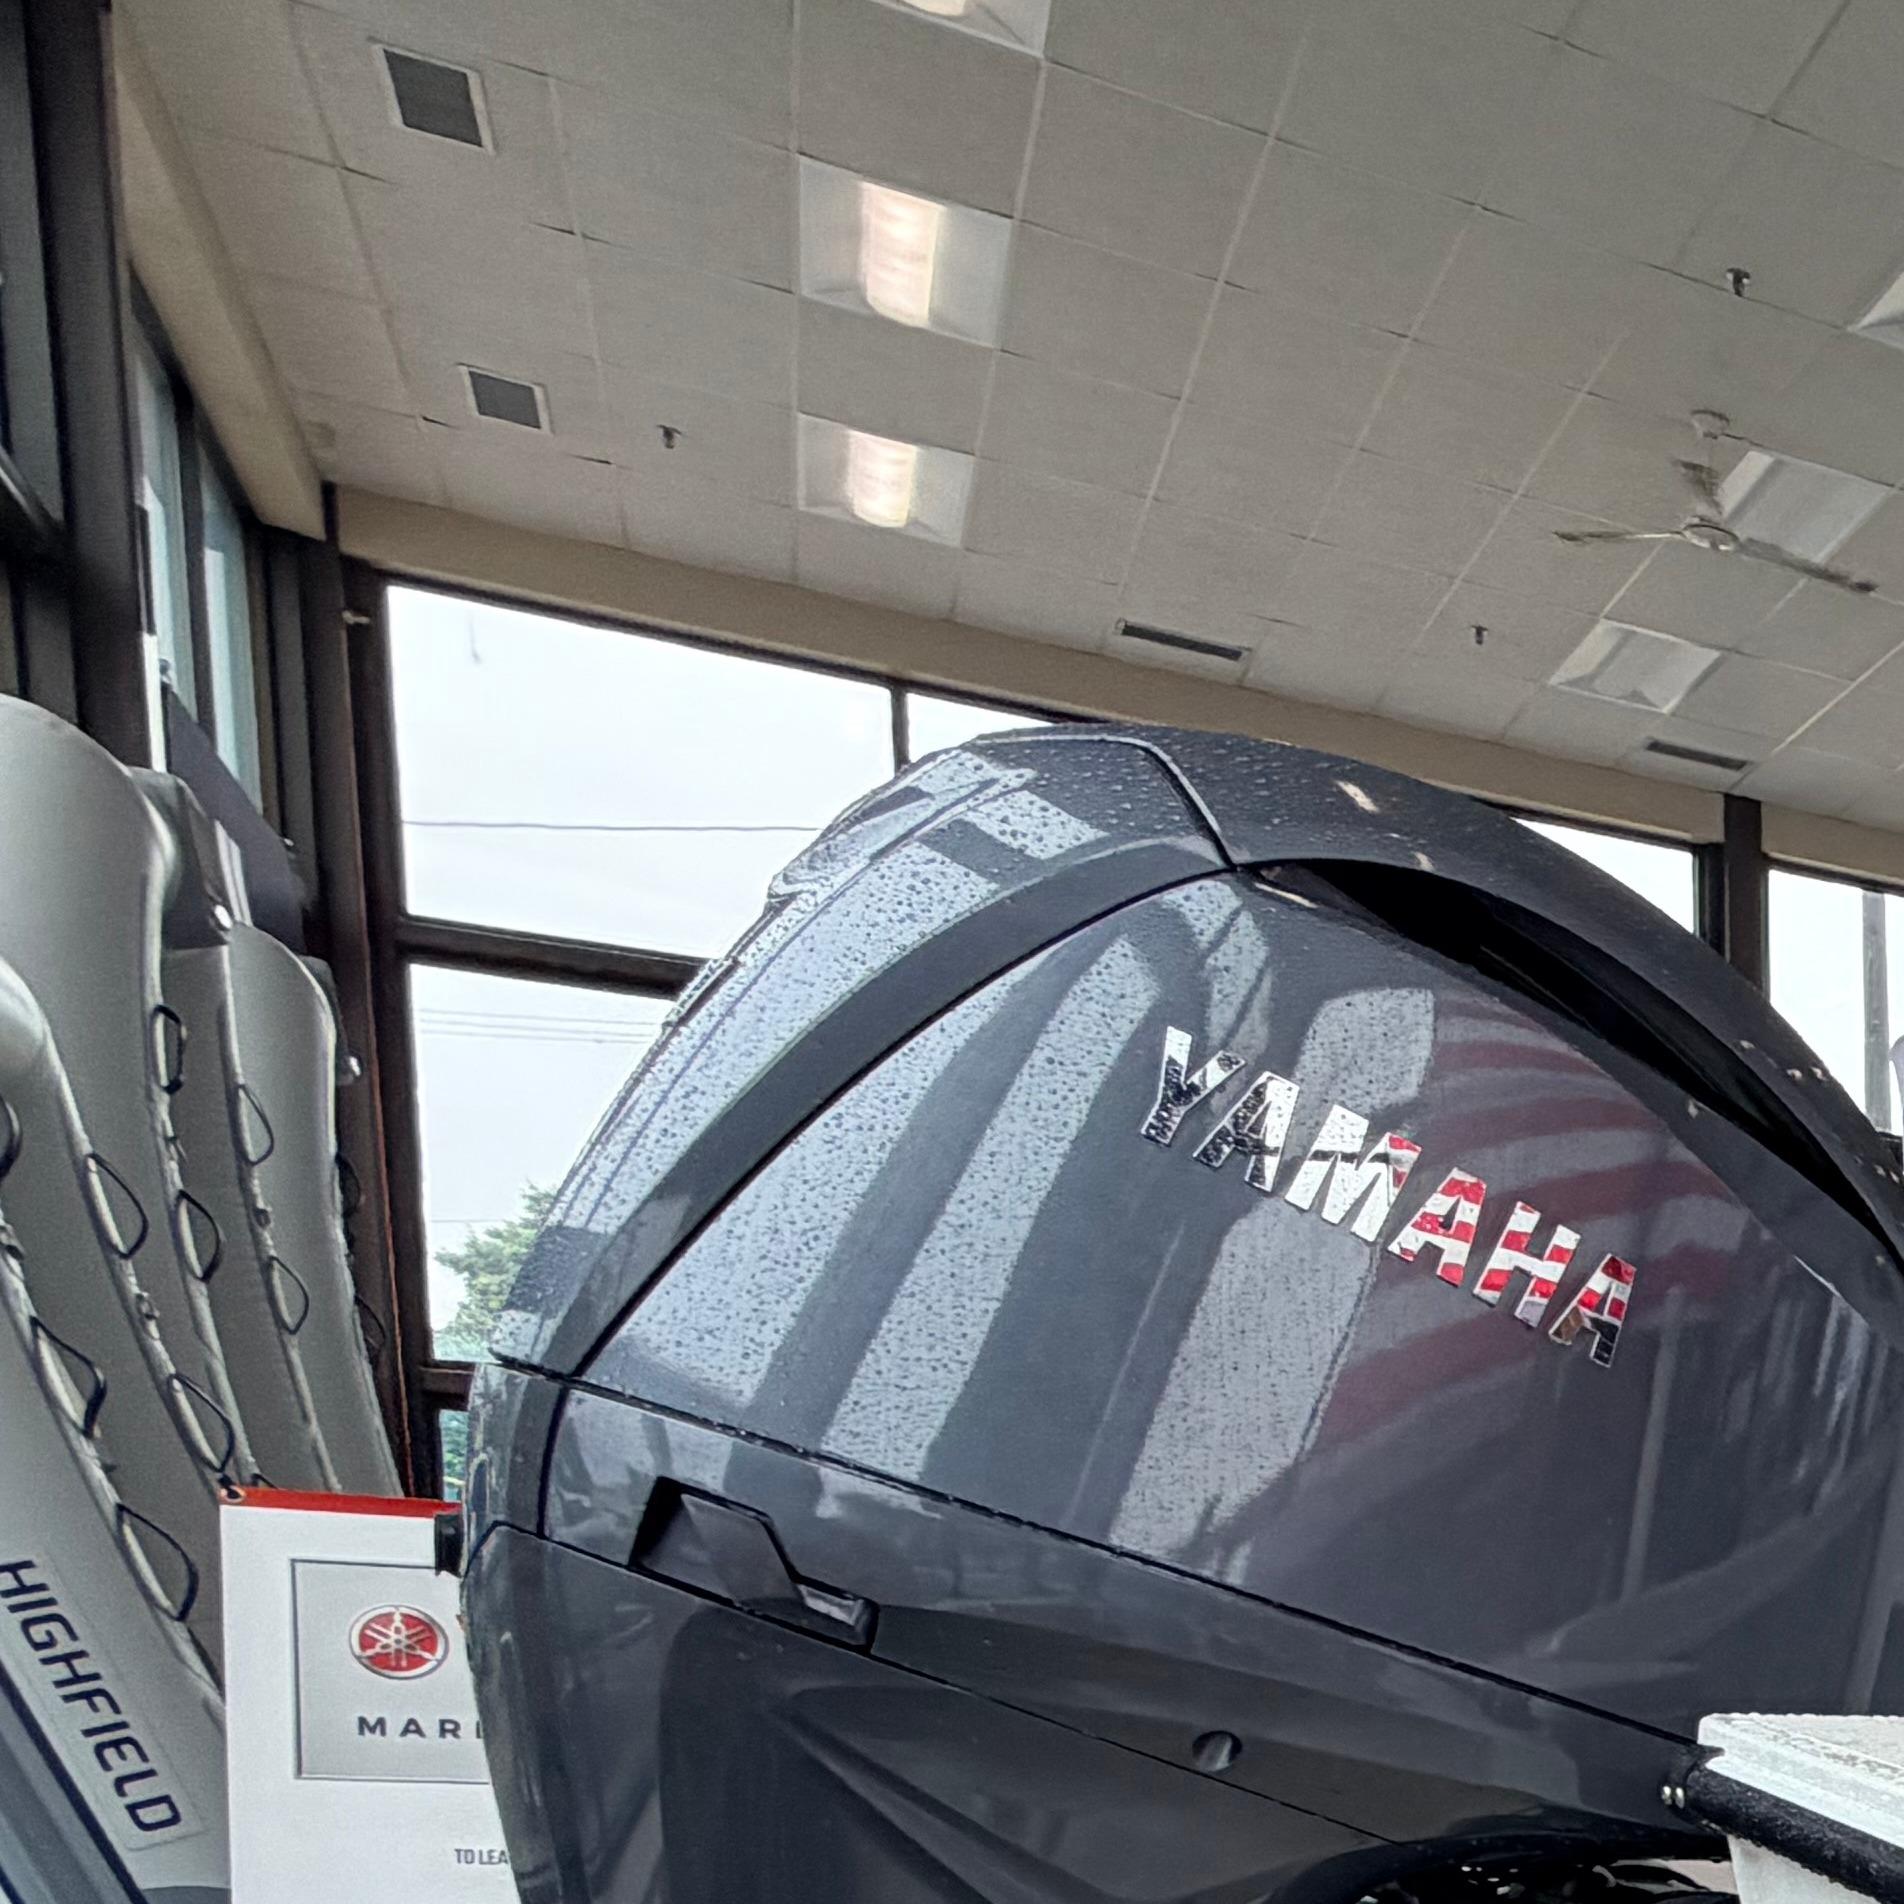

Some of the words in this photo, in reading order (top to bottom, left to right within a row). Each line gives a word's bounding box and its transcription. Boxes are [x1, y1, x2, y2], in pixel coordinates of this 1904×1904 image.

[1141, 1025, 1637, 1368] YAMAHA
[0, 1559, 182, 1832] HIGHFIELD
[454, 1848, 475, 1864] TO
